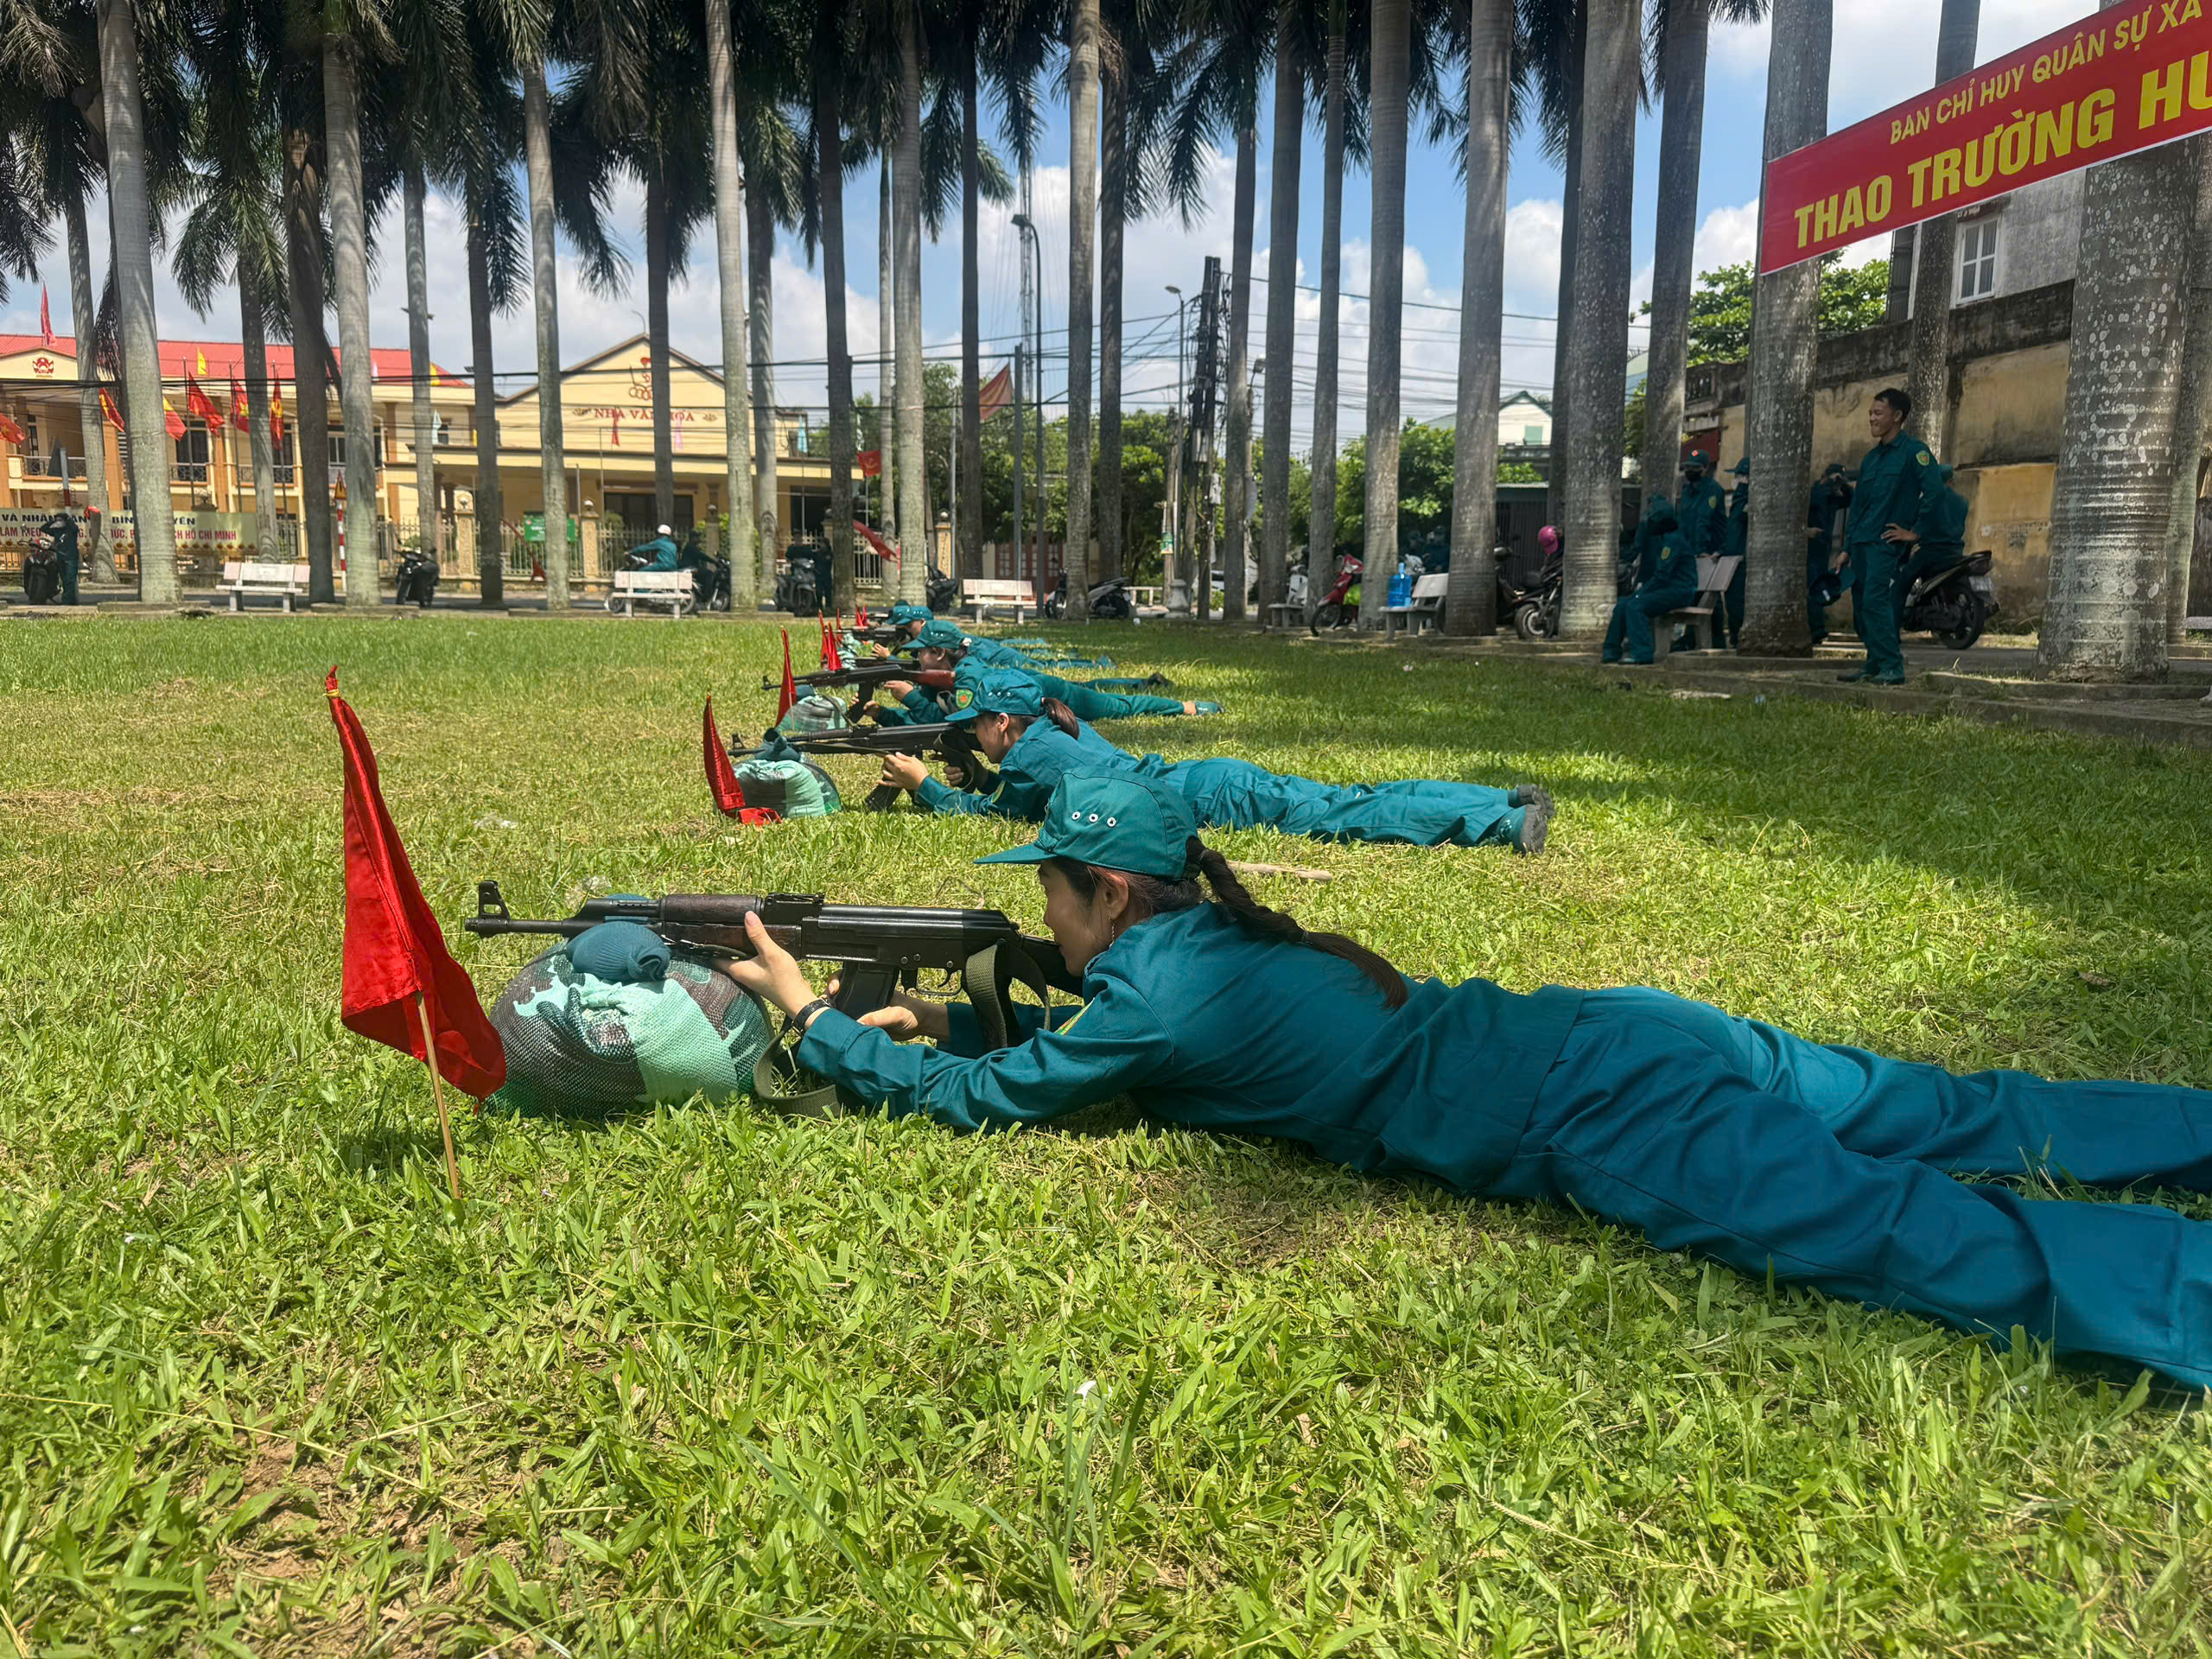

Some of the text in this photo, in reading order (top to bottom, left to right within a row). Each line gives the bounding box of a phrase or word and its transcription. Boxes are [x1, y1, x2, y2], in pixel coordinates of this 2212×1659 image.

[1890, 106, 1929, 145] BAN
[1936, 80, 1974, 124] CHỈ
[1980, 64, 2025, 107] HUY
[2032, 29, 2107, 84] QUÂN
[2113, 5, 2152, 51] SỰ
[1795, 175, 1892, 250] THAO
[1907, 88, 2115, 209] TRƯỜNG
